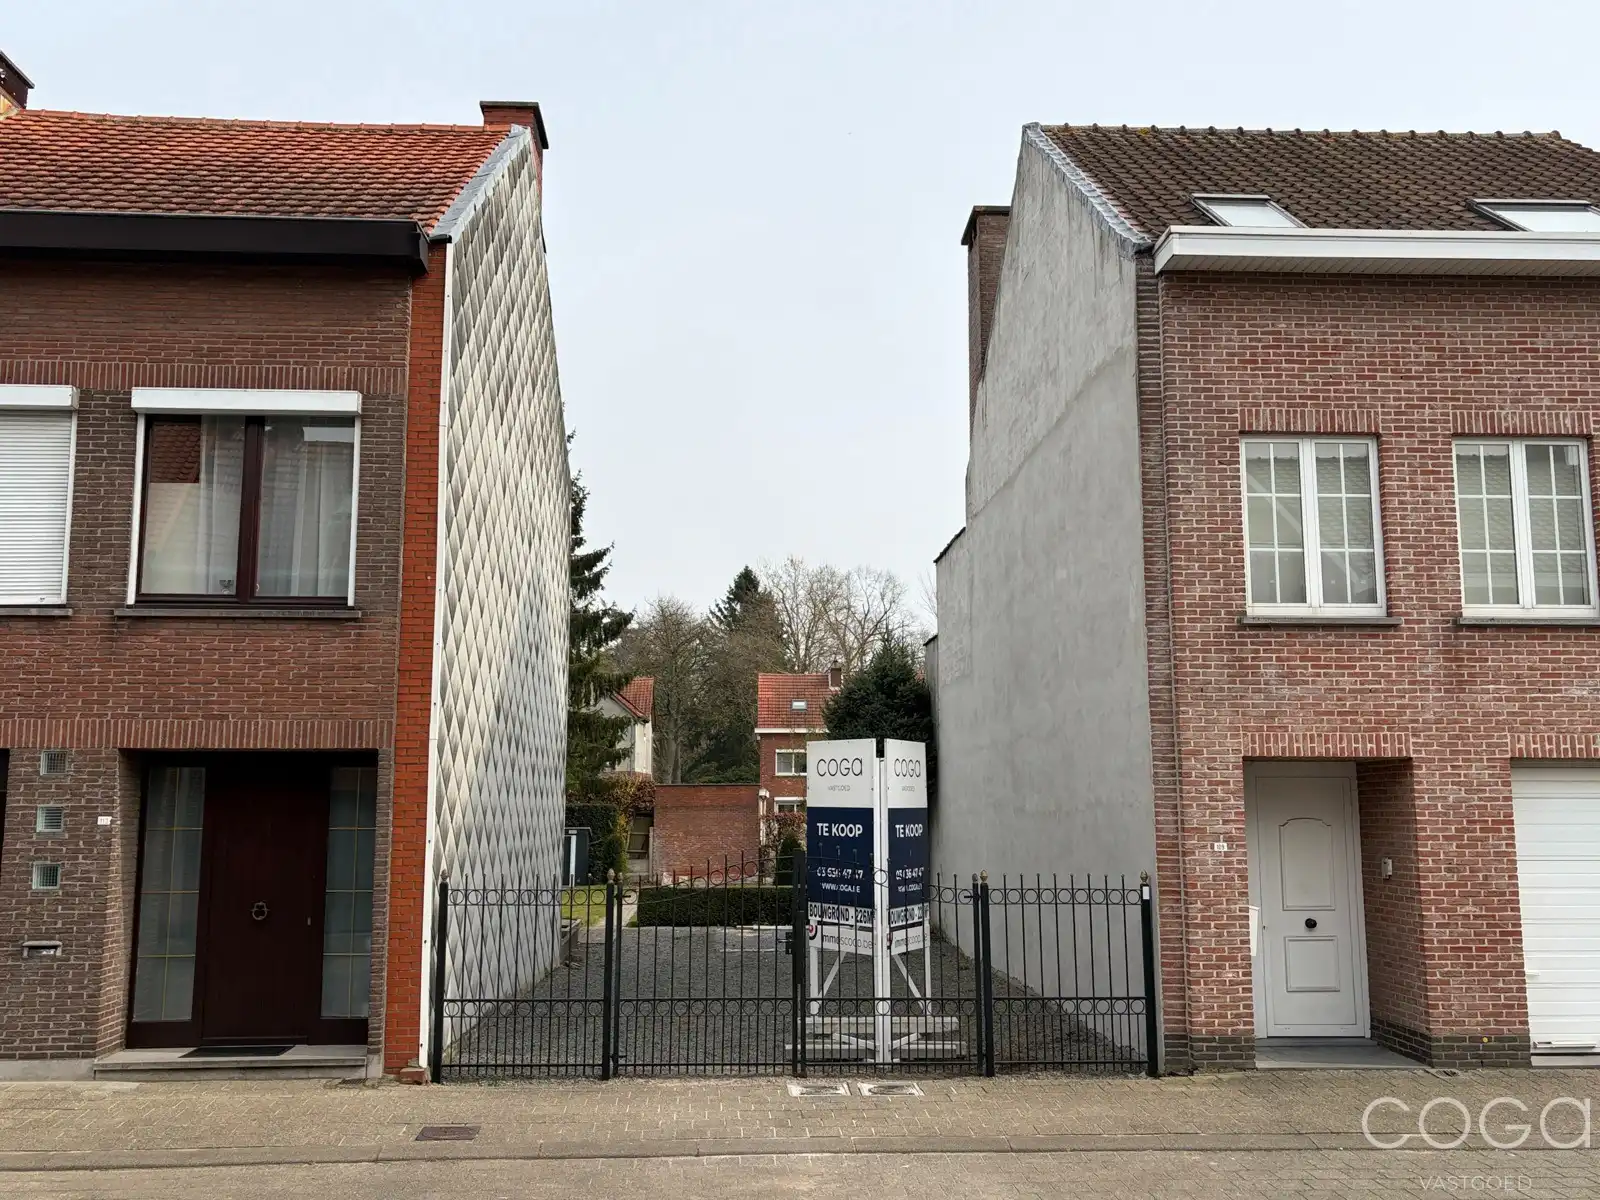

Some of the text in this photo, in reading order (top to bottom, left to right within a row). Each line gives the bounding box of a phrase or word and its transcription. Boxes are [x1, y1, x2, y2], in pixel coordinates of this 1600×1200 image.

[816, 823, 863, 838] TE KOOP
[895, 824, 923, 838] TE KOOP
